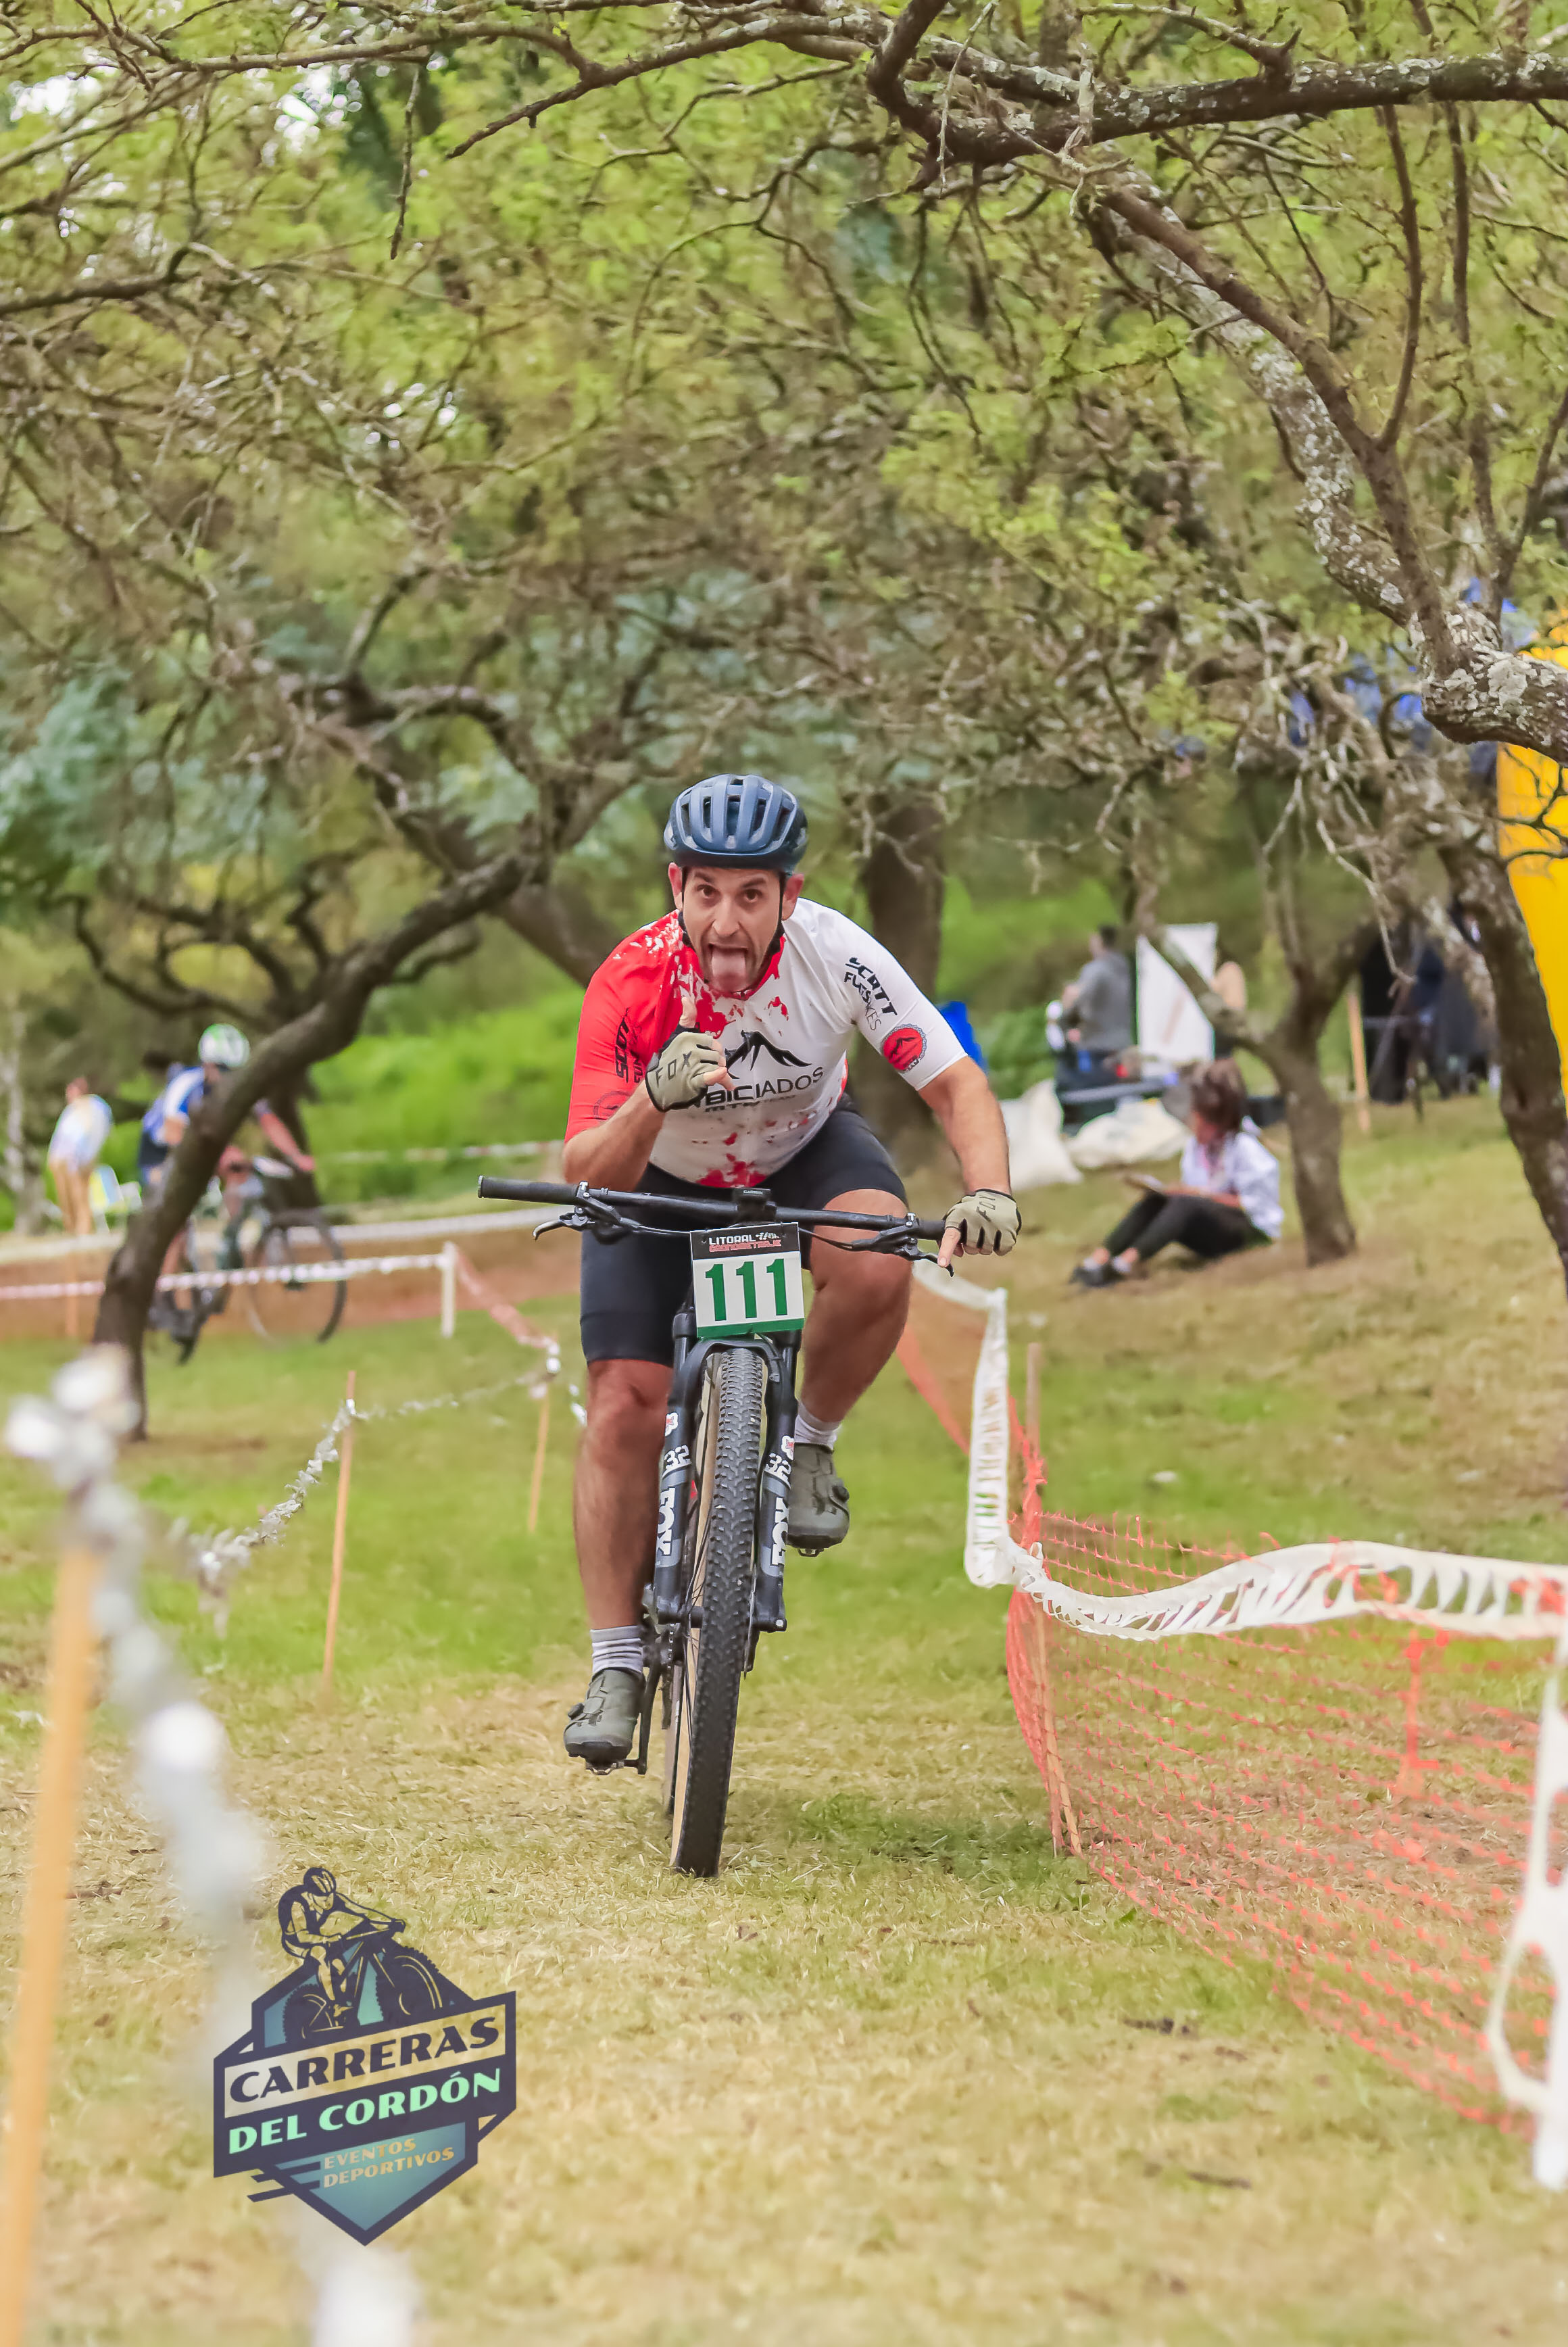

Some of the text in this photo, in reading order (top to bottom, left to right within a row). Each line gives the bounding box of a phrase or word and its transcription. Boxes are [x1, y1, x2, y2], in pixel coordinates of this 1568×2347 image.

[655, 1051, 692, 1088] FOX
[692, 1067, 824, 1109] BICIADOS
[708, 1234, 756, 1245] LITORAL
[705, 1258, 788, 1322] 111
[664, 1445, 691, 1469] 32
[765, 1453, 792, 1479] 32
[657, 1487, 675, 1556] FOX
